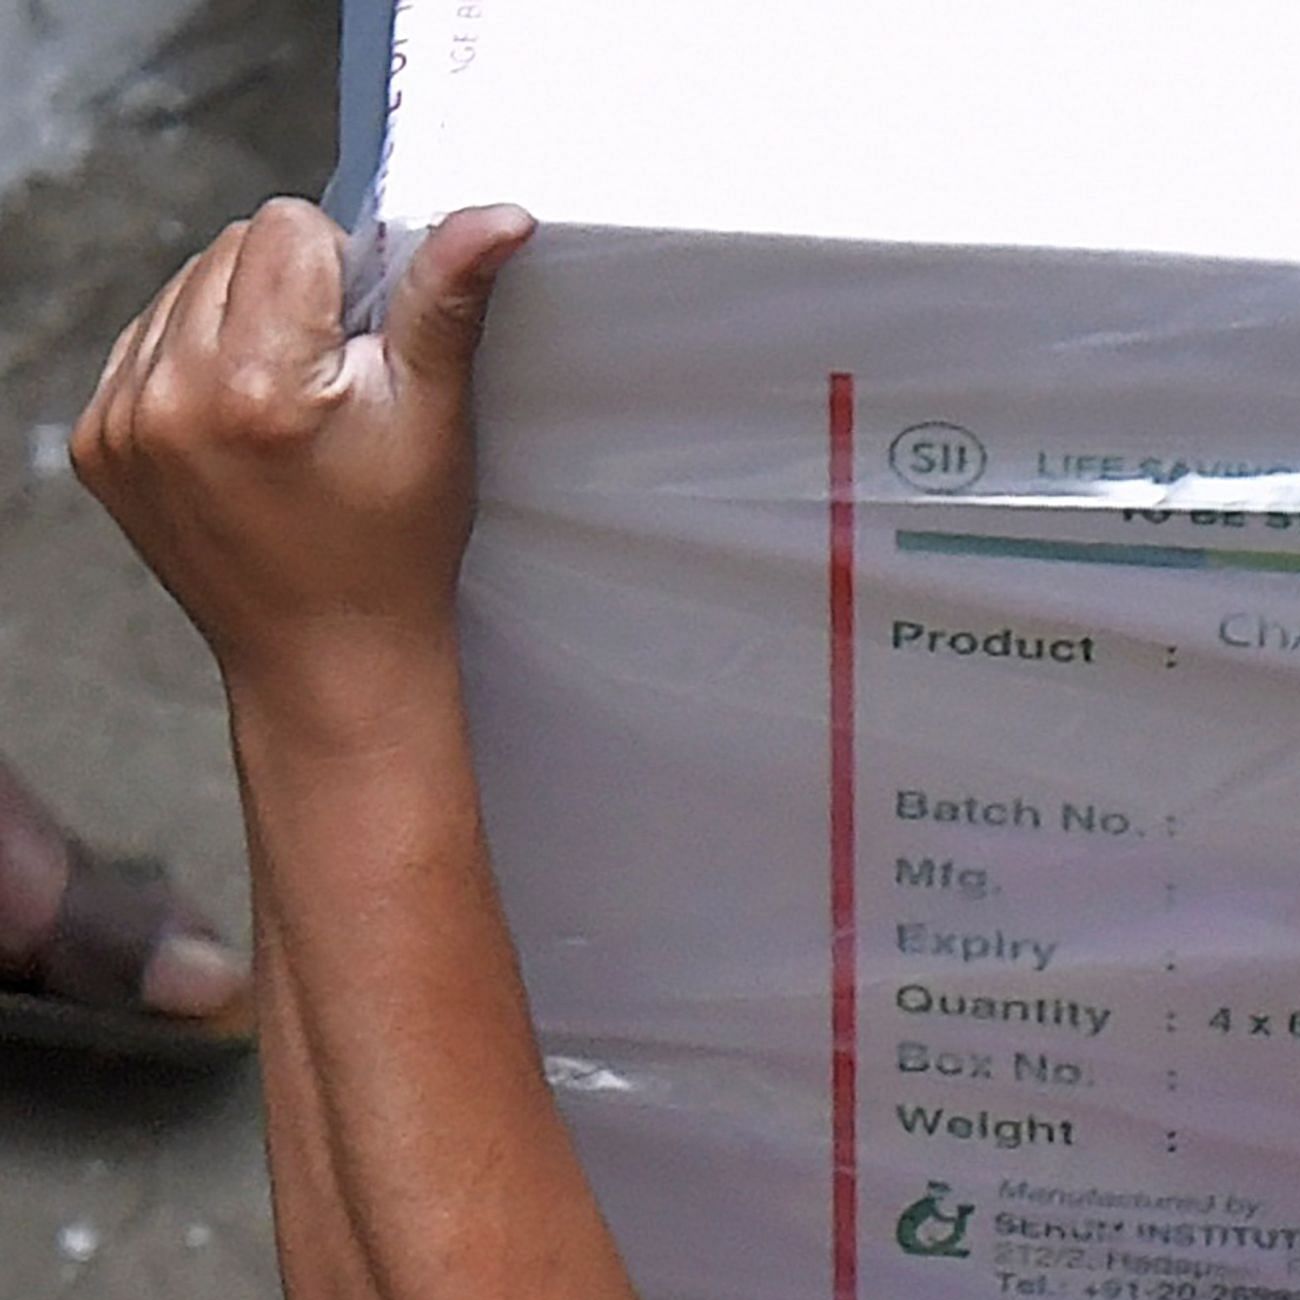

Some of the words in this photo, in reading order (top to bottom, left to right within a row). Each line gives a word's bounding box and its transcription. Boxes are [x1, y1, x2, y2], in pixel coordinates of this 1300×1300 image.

[909, 443, 967, 474] SII
[1037, 450, 1126, 480] LIFE
[892, 620, 1096, 663] Product
[895, 790, 1041, 828] Batch
[1062, 803, 1145, 837] No.
[895, 857, 1002, 900] Mfg.
[896, 922, 1057, 972] Expiry
[895, 983, 1111, 1037] Quantity
[1208, 1006, 1232, 1036] 4
[1249, 1012, 1270, 1038] x
[896, 1042, 992, 1079] Box
[896, 1104, 1073, 1149] Weight
[1225, 1195, 1260, 1220] by
